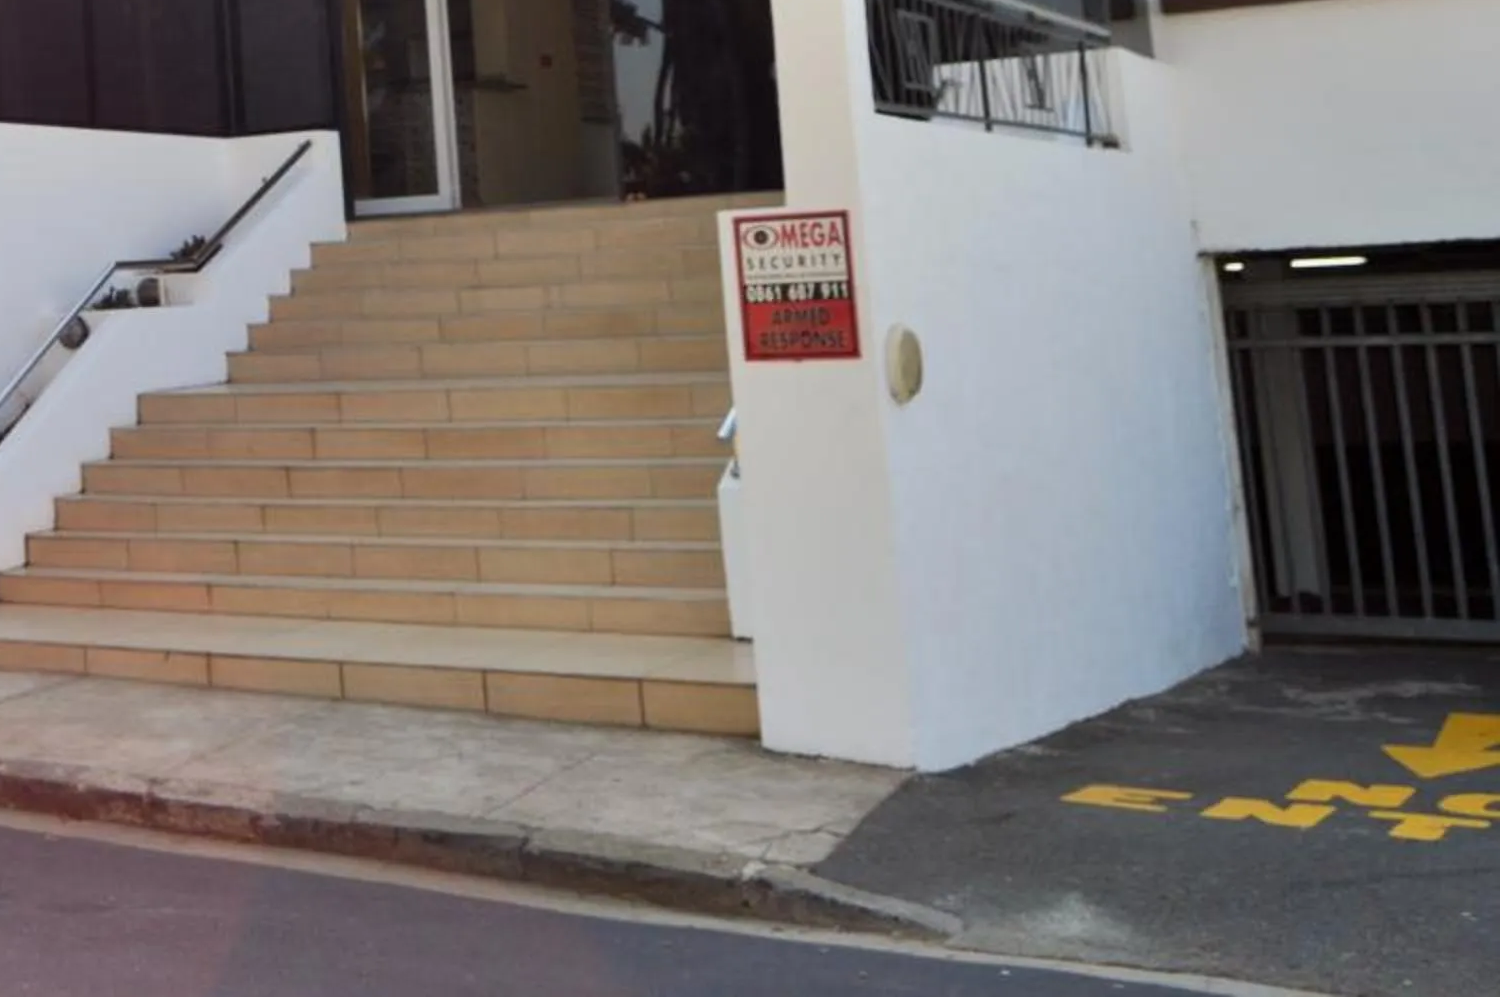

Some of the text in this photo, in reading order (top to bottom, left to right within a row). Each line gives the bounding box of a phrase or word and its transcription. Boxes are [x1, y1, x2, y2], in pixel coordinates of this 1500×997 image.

[747, 254, 842, 270] SECURITY
[820, 281, 849, 299] 911
[772, 307, 830, 325] ARMED
[760, 330, 846, 348] RESPONSE
